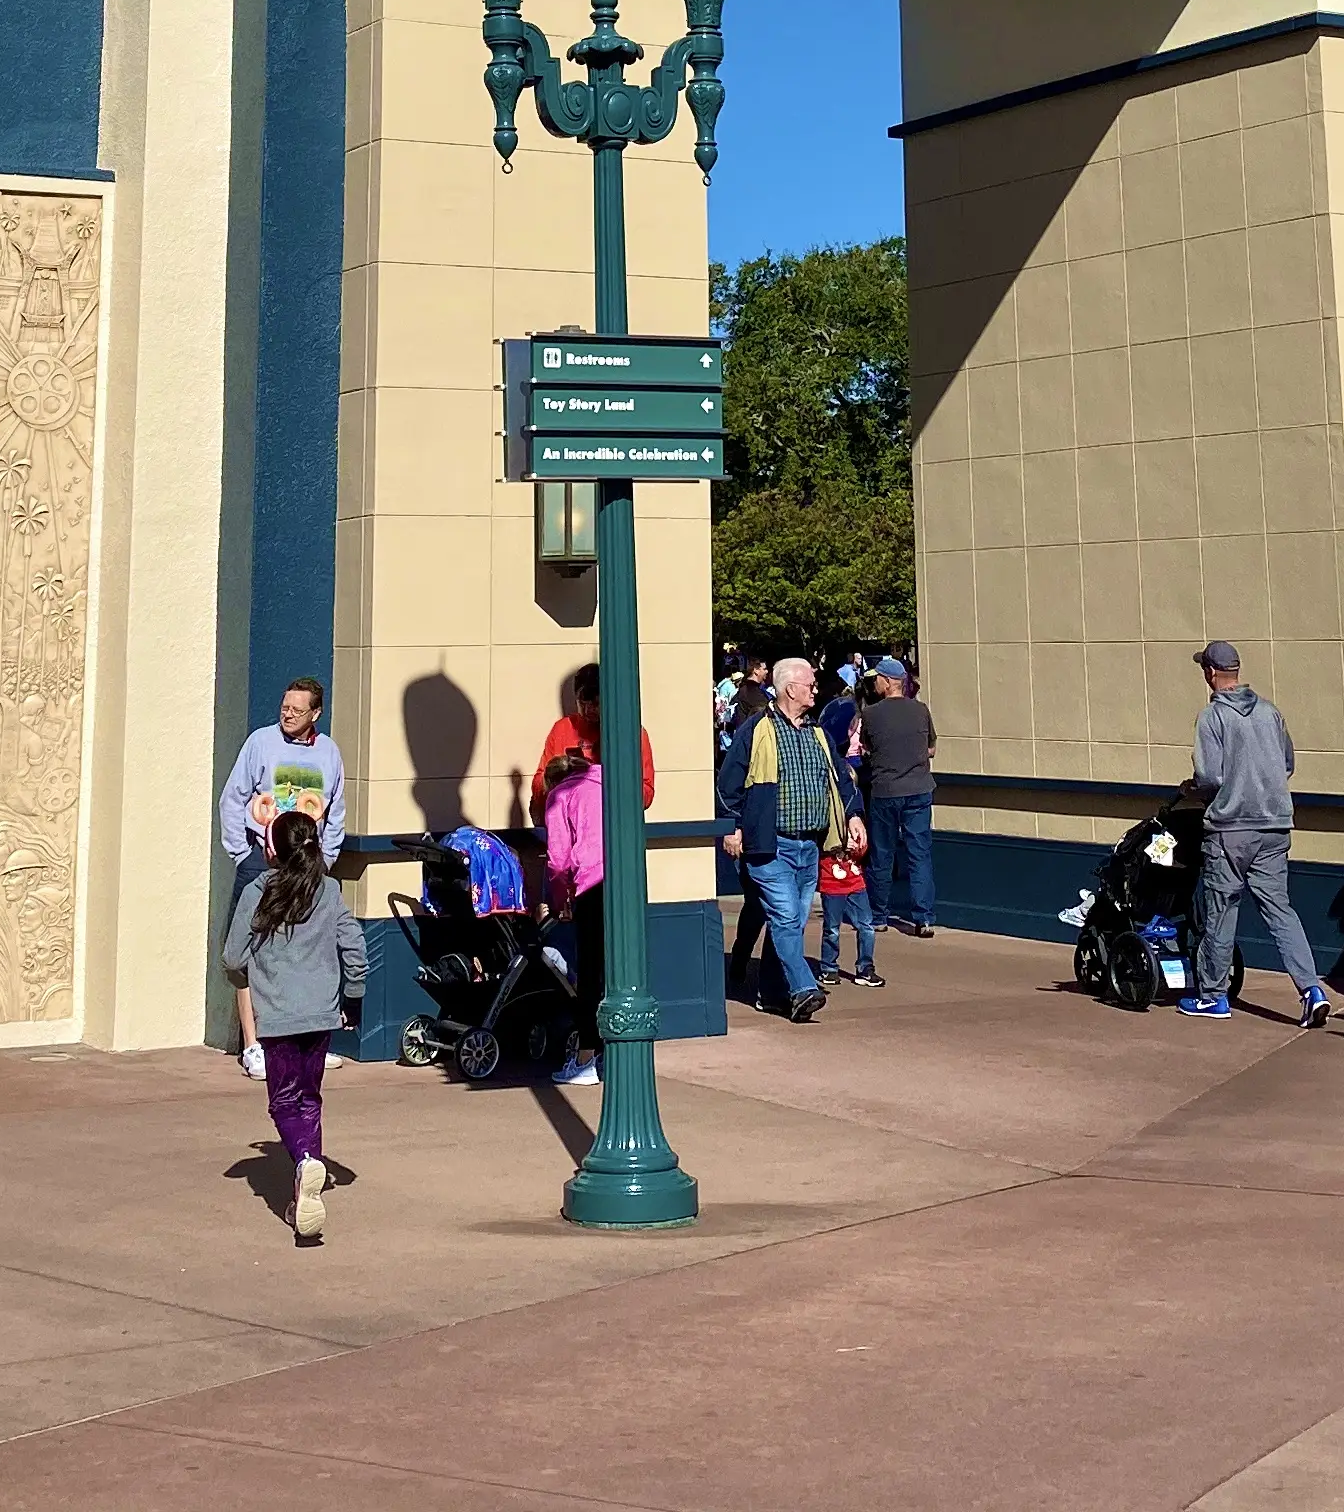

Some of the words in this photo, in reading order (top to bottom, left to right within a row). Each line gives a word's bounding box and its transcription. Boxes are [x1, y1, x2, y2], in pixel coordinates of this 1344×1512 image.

[566, 352, 631, 367] Restrooms
[542, 397, 565, 413] Toy
[568, 398, 601, 413] Story
[604, 398, 635, 412] Land
[542, 447, 561, 460] An
[563, 447, 626, 461] Incredible
[628, 448, 698, 461] Celebration
